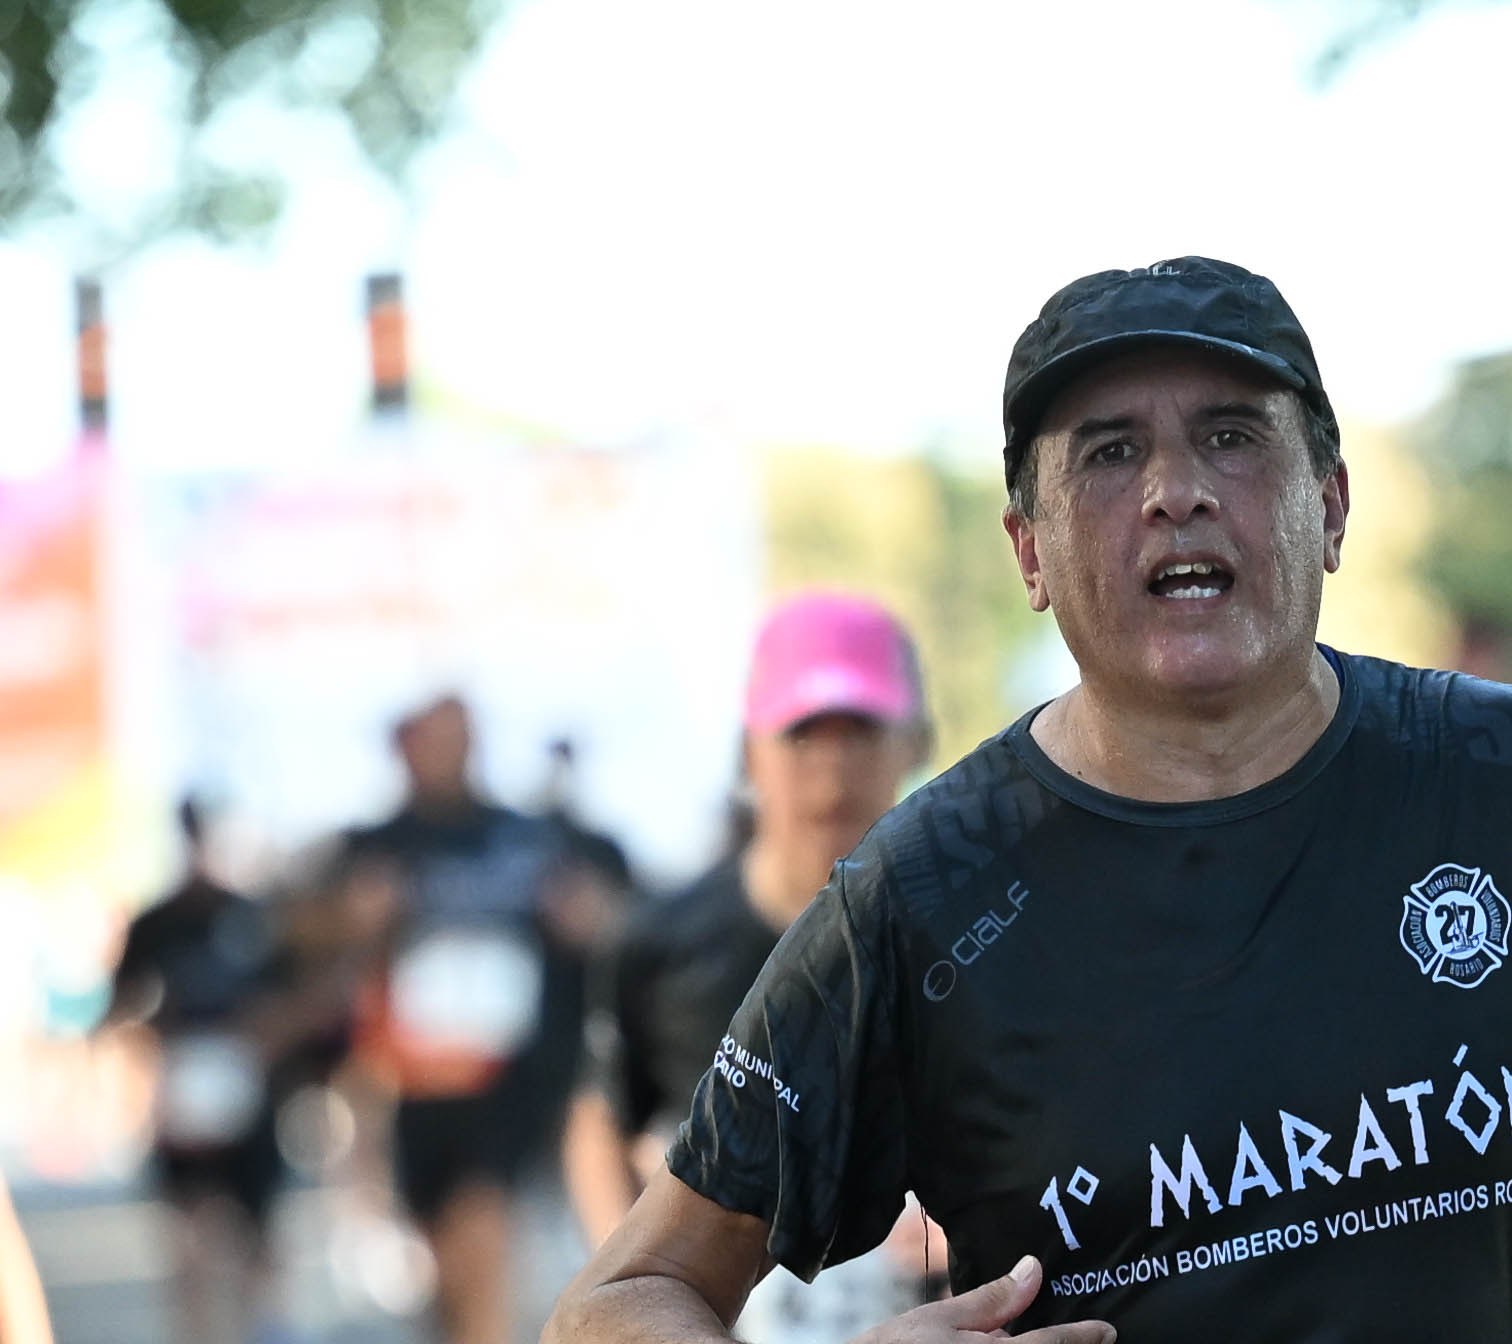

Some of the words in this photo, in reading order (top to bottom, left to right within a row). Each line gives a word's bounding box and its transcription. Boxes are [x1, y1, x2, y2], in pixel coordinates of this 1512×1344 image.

[1050, 1253, 1170, 1297] ASOCIACIÓN
[1176, 1220, 1319, 1274] BOMBEROS
[1324, 1184, 1489, 1239] VOLUNTARIOS
